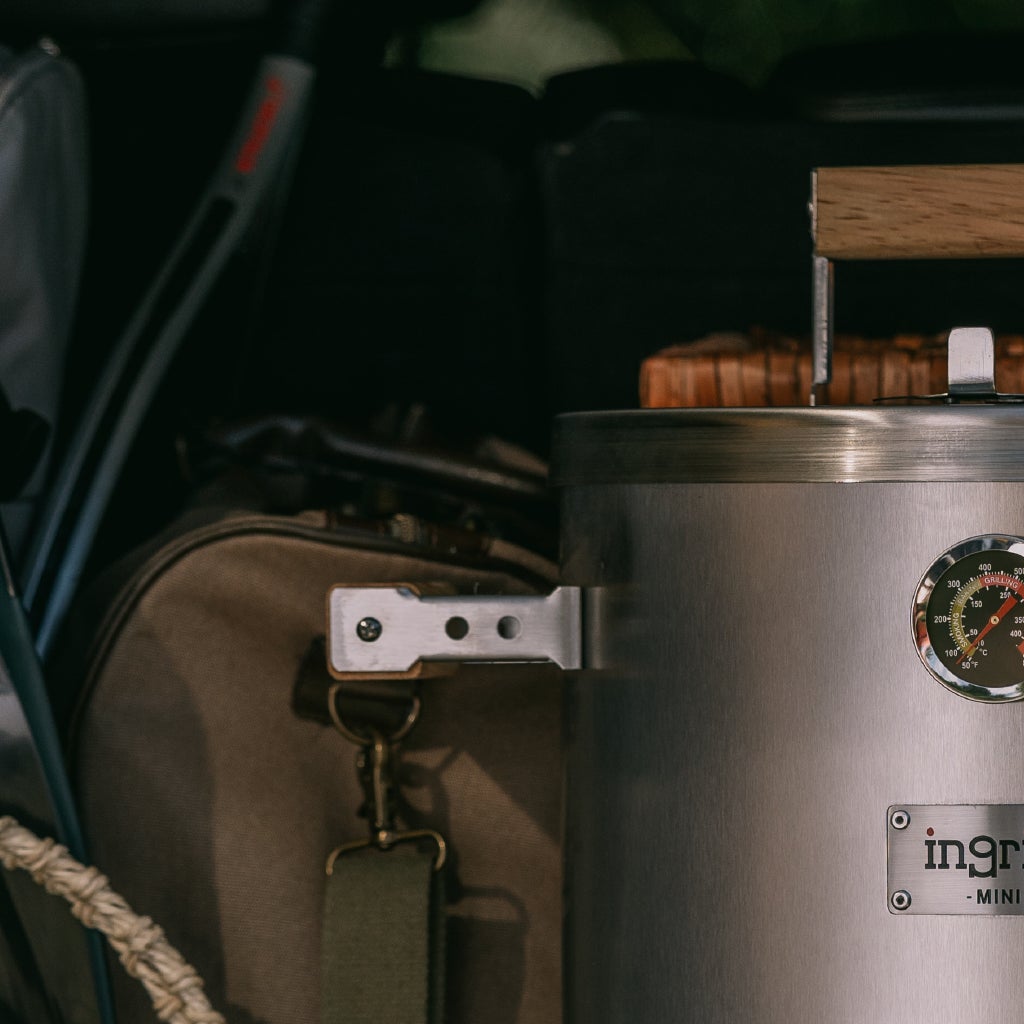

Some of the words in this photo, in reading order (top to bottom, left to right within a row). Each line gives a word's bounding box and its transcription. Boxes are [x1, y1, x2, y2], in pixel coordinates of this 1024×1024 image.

[947, 580, 960, 588] 300
[984, 577, 1019, 589] GRILLING
[934, 615, 948, 623] 200
[953, 612, 967, 648] SMOKING
[969, 628, 978, 636] 50
[945, 649, 958, 657] 100
